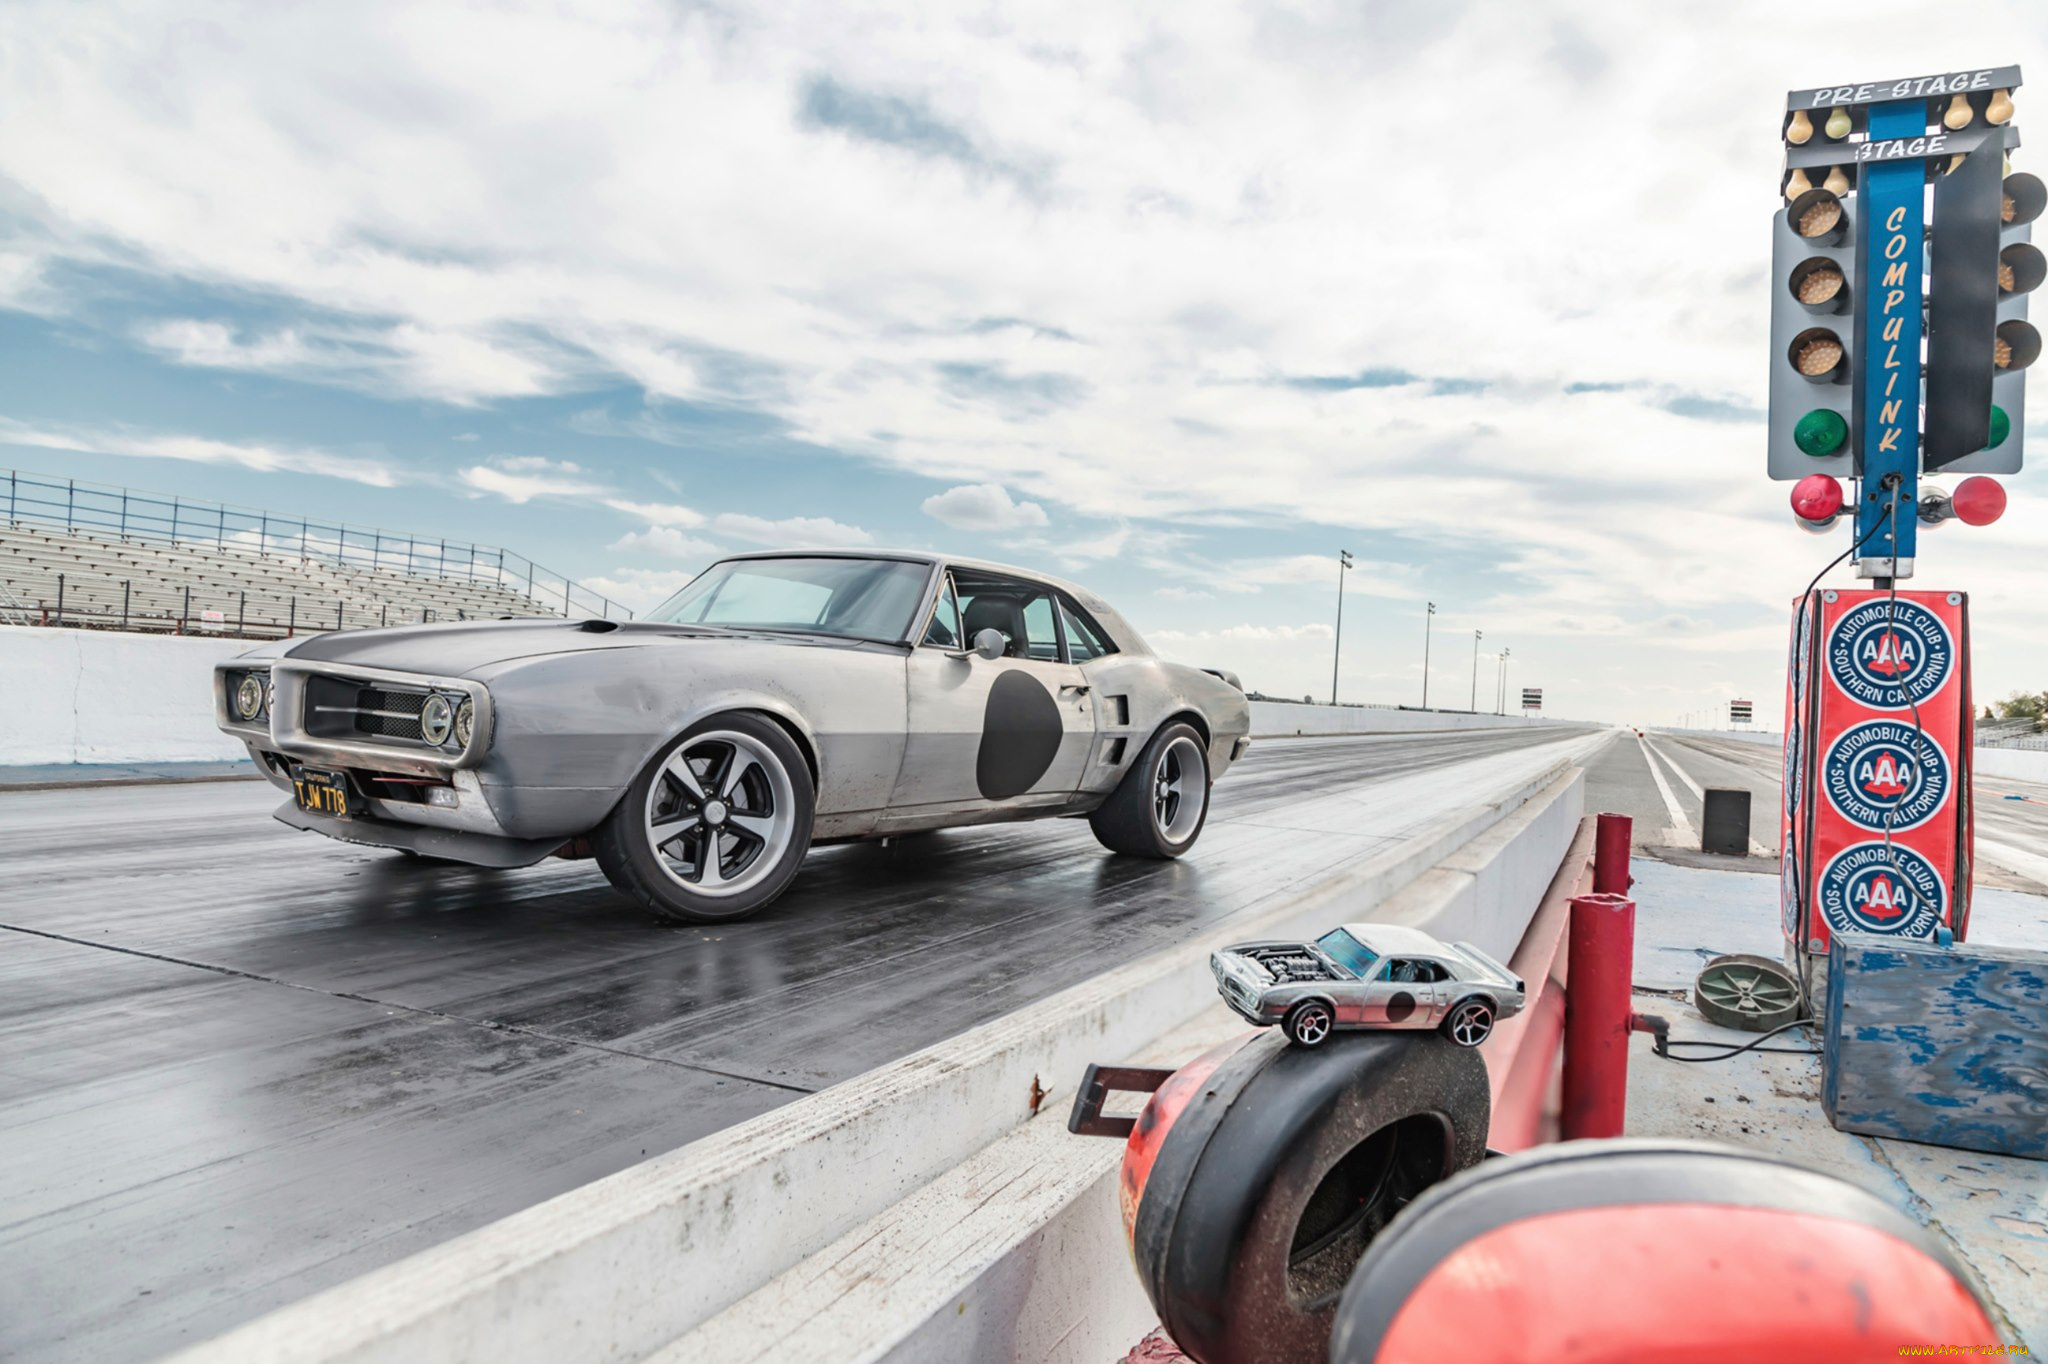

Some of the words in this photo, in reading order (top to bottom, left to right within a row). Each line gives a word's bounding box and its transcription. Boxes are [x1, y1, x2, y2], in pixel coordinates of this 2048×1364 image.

[1812, 70, 1993, 107] PRE-STAGE
[1854, 135, 1948, 161] STAGE
[1878, 206, 1908, 453] COMPULINK
[1838, 604, 1916, 643] AUTOMOBILE
[1913, 614, 1943, 645] CLUB
[1862, 638, 1916, 665] AAA
[1834, 648, 1884, 703] SOUTHERN
[1886, 651, 1946, 704] CAIFORNIA
[1835, 726, 1913, 763] AUTOMOBILE
[1859, 759, 1912, 787] AAA
[321, 786, 347, 815] 778
[1831, 768, 1880, 824] SOUTHERN
[1883, 775, 1943, 825] CALIFORNIA
[1906, 860, 1935, 892] CLUB
[1826, 889, 1867, 933] SOUTHE
[1854, 881, 1908, 910] AAA
